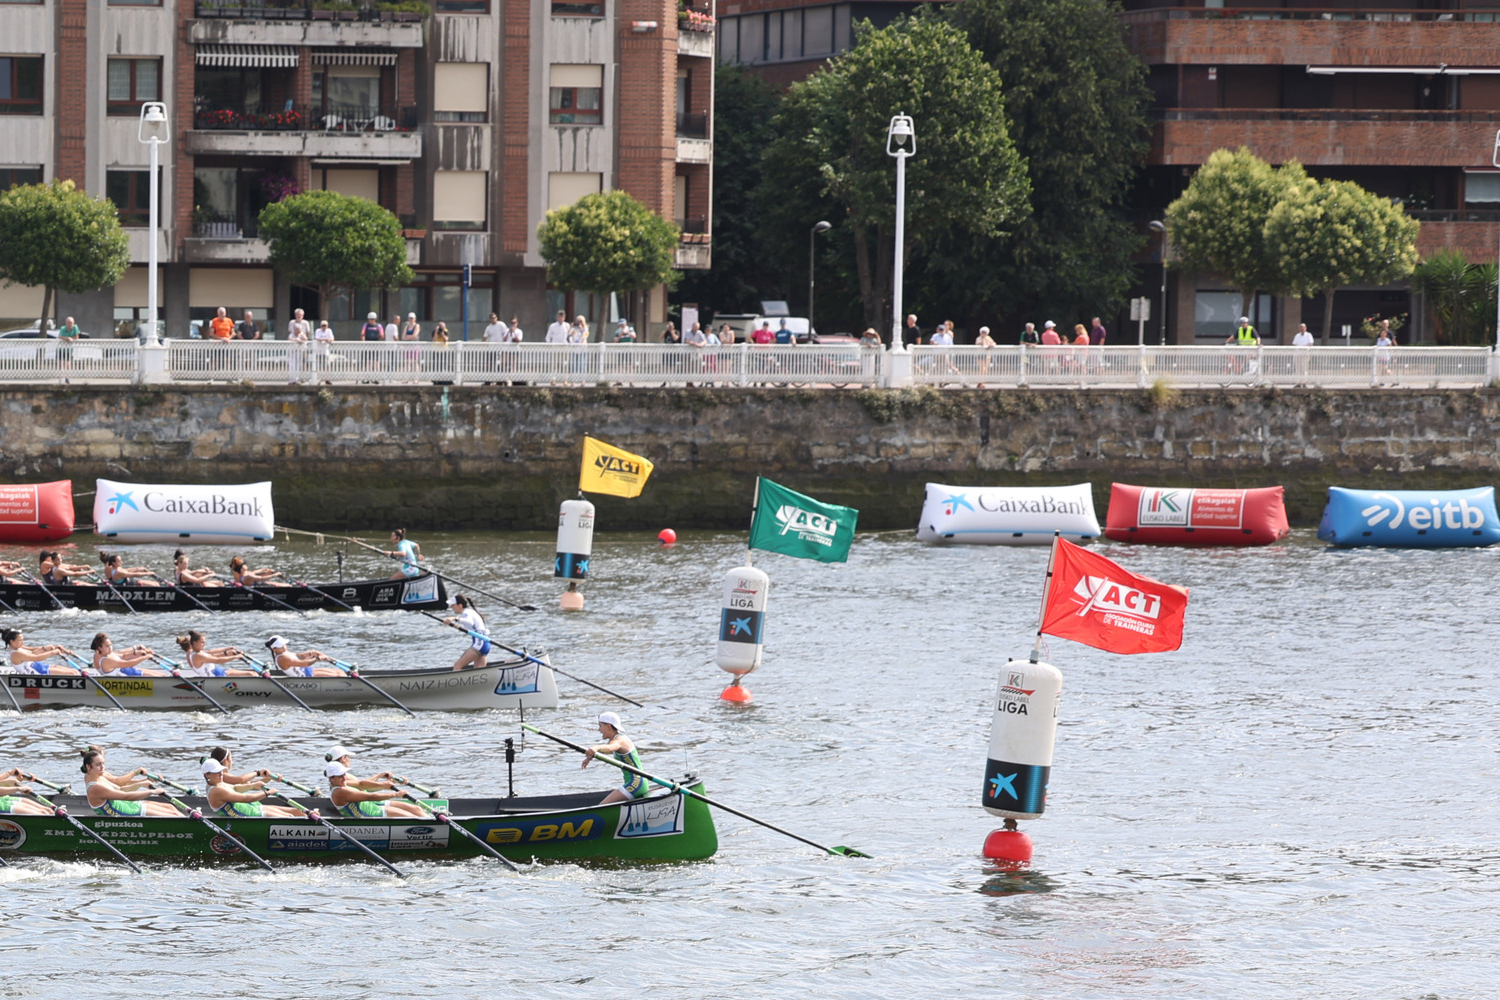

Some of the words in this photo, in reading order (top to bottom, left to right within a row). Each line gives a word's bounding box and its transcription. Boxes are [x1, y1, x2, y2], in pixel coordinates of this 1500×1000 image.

[145, 491, 264, 518] CaixaBank
[977, 493, 1090, 518] CaixaBank
[1143, 514, 1164, 522] EUSKO
[1165, 514, 1185, 522] LABEL
[1408, 498, 1484, 530] eitb
[797, 511, 838, 533] ACT
[96, 590, 176, 601] MADALEN
[1102, 585, 1156, 613] ACT
[730, 598, 754, 609] LIGA
[1114, 620, 1154, 636] TRAINERAS
[10, 677, 85, 689] DRUCK
[235, 690, 271, 698] ORVY
[998, 700, 1028, 715] LIGA
[94, 821, 143, 829] gipuzkoa
[528, 819, 594, 842] BM
[270, 829, 316, 837] ALKAIN
[287, 840, 328, 848] aiadek
